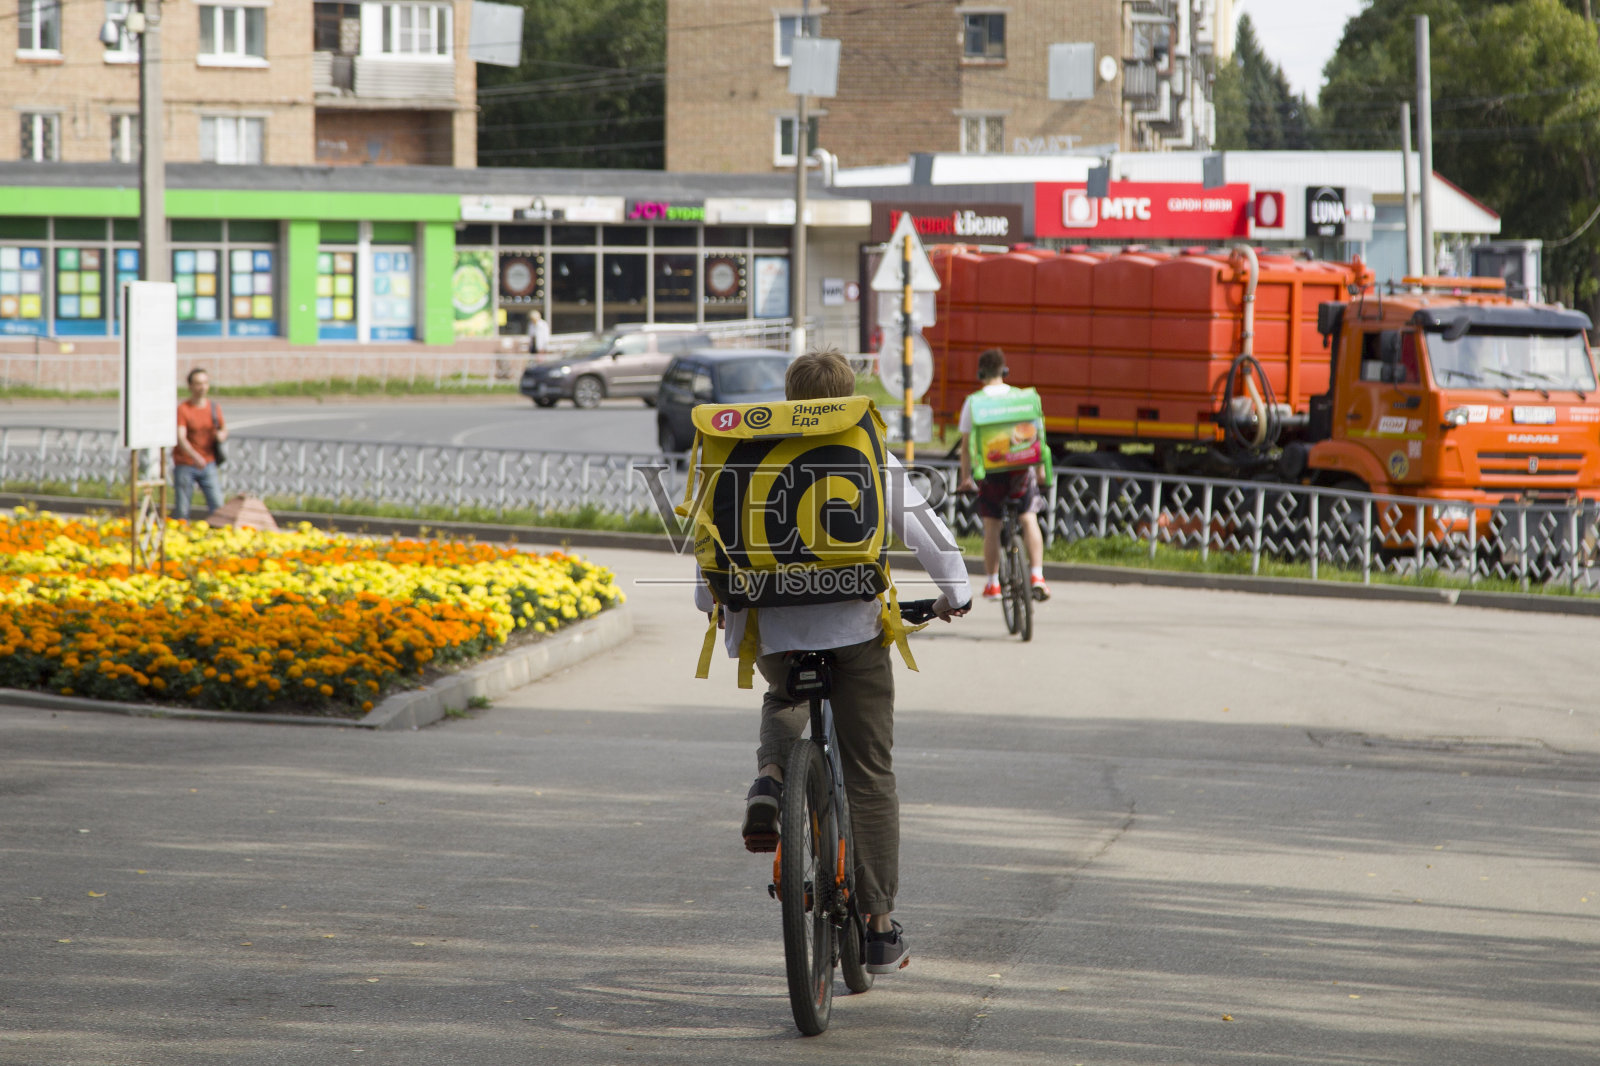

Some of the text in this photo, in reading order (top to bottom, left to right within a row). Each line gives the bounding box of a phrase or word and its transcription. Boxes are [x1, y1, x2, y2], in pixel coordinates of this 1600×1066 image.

[628, 202, 670, 219] JOY
[1101, 197, 1151, 220] МТС
[1311, 199, 1345, 225] LUNA
[793, 403, 847, 416] Яндекс
[791, 414, 819, 427] Еда
